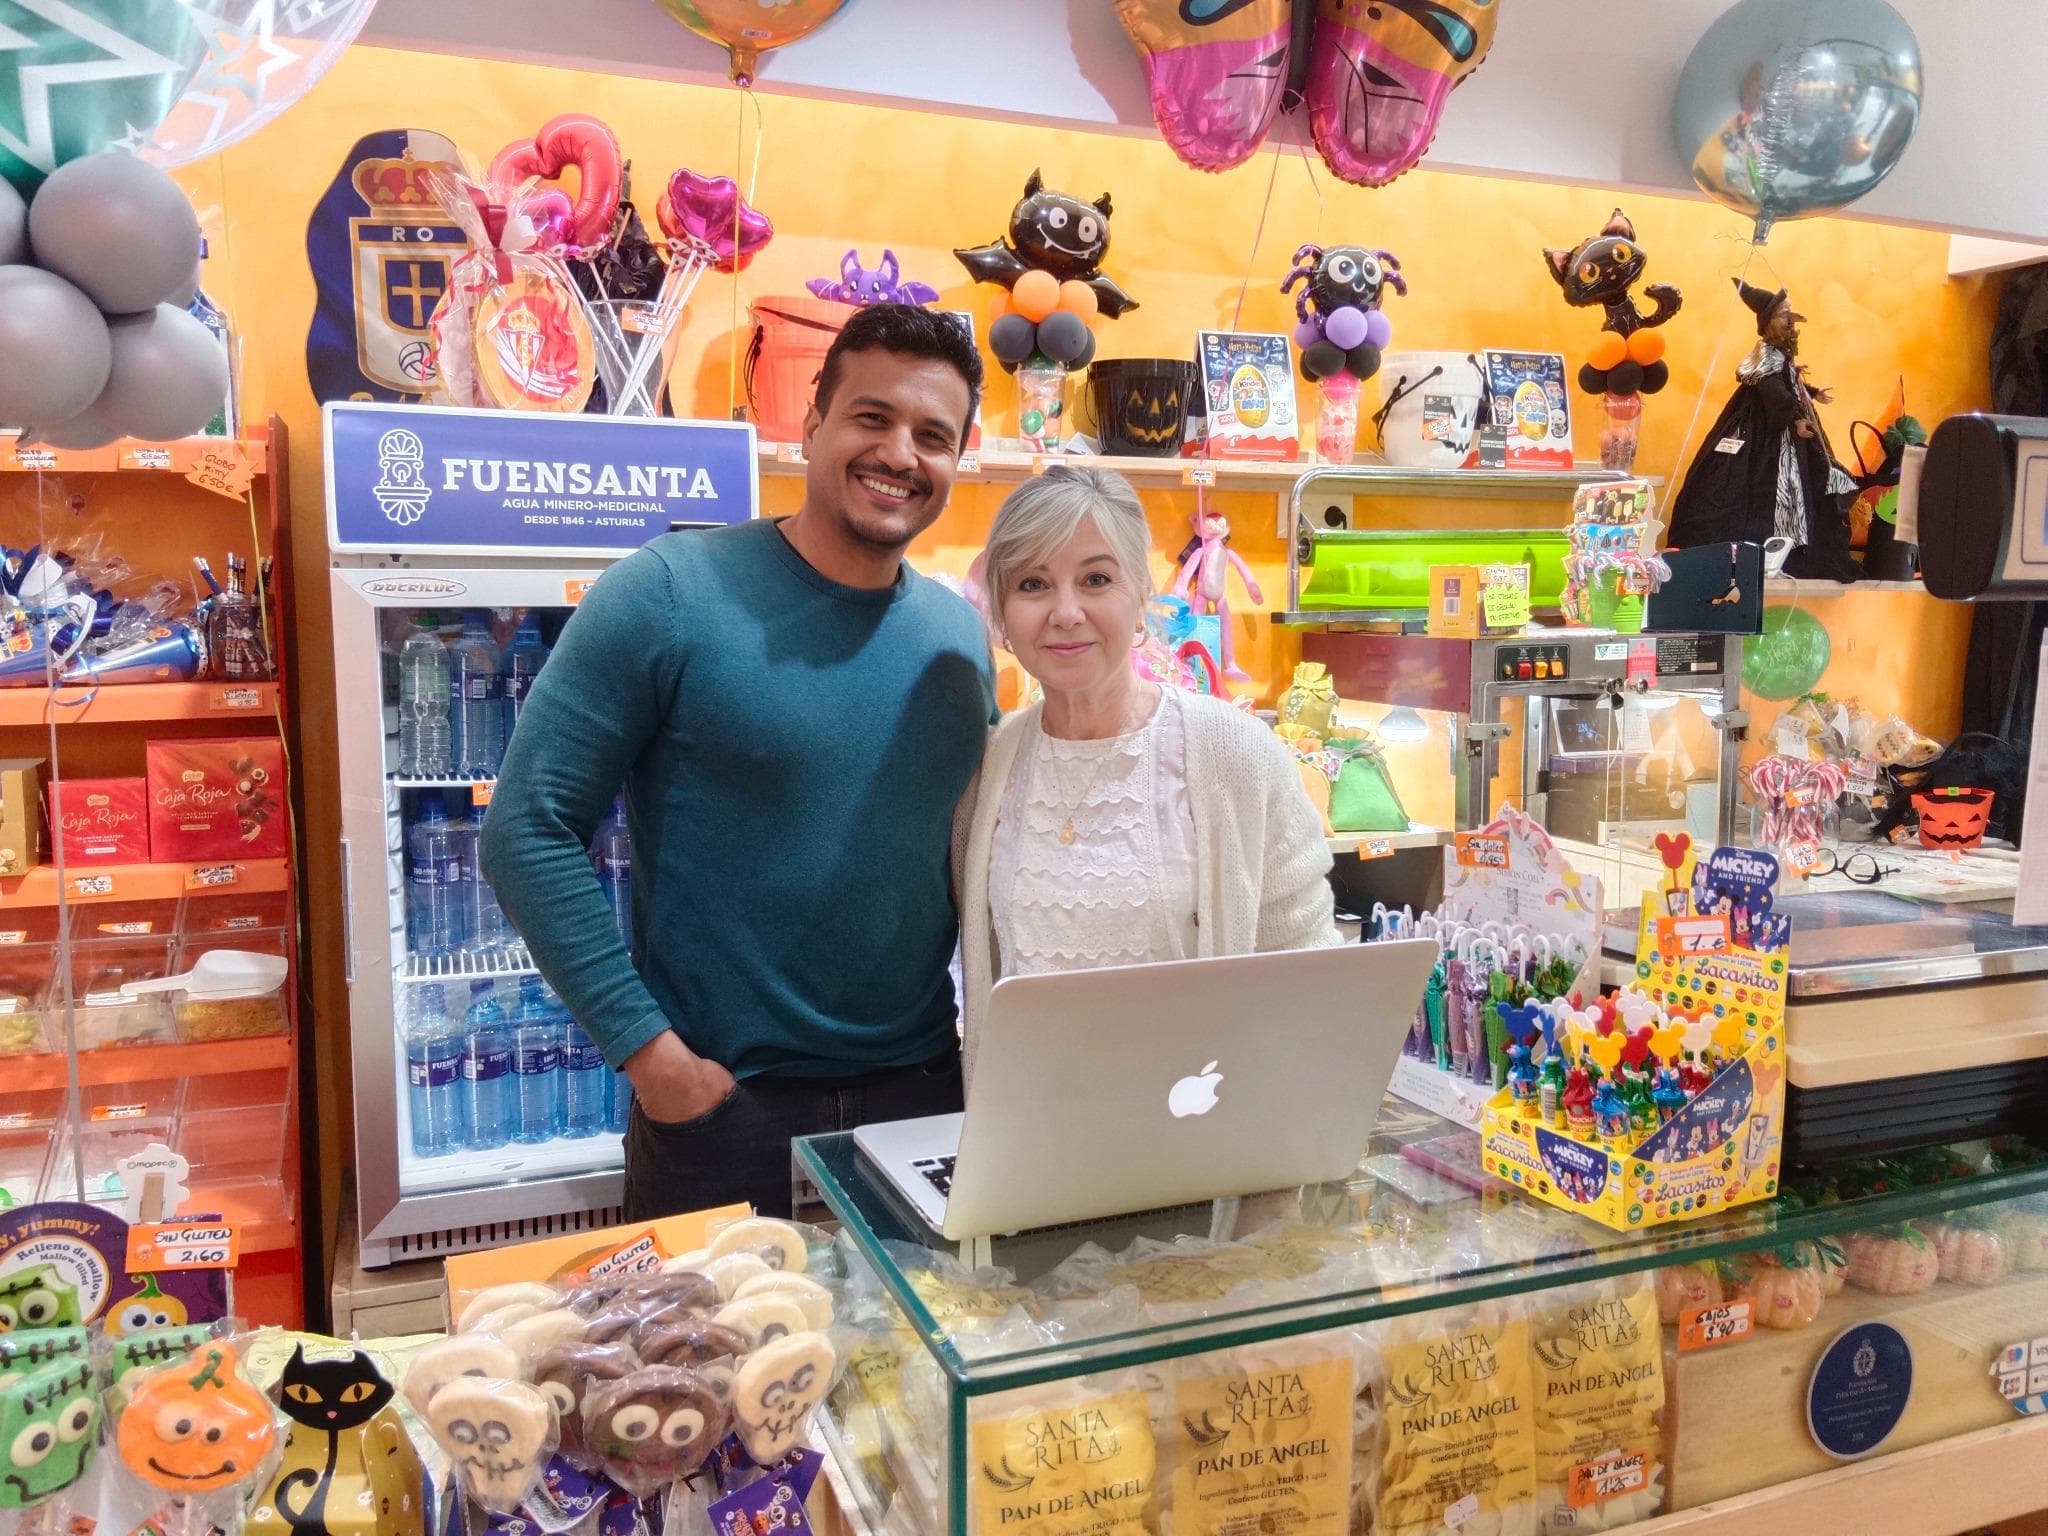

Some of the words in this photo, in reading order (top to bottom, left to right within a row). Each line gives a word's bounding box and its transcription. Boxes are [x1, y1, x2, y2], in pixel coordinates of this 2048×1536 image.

[205, 454, 236, 471] GLOBO
[441, 458, 719, 500] FUENSANTA
[502, 498, 540, 510] AGUA
[544, 499, 666, 513] MINERO-MEDICINAL
[524, 515, 559, 525] DESDE
[562, 516, 585, 526] 1846
[595, 516, 646, 528] ASTURIAS
[156, 787, 187, 808] Caja
[185, 783, 231, 806] Roja
[62, 812, 91, 832] Caja
[94, 807, 136, 830] Roja
[1712, 856, 1774, 879] MICKEY
[1718, 872, 1734, 880] AND
[1735, 875, 1766, 886] FRIENDS
[1694, 958, 1779, 991] Lacasitos
[1693, 1099, 1725, 1112] MICKEY
[1486, 1137, 1542, 1171] Lacasitos
[1554, 1144, 1594, 1168] MICKEY
[1655, 1174, 1725, 1202] Lacasitos
[17, 1217, 101, 1241] yummy!
[155, 1231, 179, 1244] SIN
[181, 1228, 232, 1243] GLUTEN
[16, 1242, 70, 1261] Relleno
[72, 1245, 87, 1259] de
[612, 1236, 655, 1265] GLUTEN
[40, 1253, 76, 1265] Mallow
[75, 1263, 89, 1286] filled
[1568, 1299, 1632, 1332] SANTA
[1425, 1333, 1492, 1368] SANTA
[1577, 1323, 1630, 1353] RITA
[1432, 1357, 1488, 1388] RITA
[1547, 1378, 1581, 1399] PAN
[1586, 1374, 1608, 1391] DE
[1609, 1362, 1656, 1387] ANGEL
[1226, 1373, 1304, 1405] SANTA
[1231, 1396, 1296, 1426] RITA
[1402, 1415, 1436, 1436] PAN
[1440, 1408, 1462, 1429] DE
[1466, 1396, 1520, 1424] ANGEL
[1025, 1408, 1109, 1447] SANTA
[1035, 1435, 1104, 1471] RITA
[1198, 1454, 1234, 1476] PAN
[1240, 1449, 1264, 1468] DE
[1269, 1438, 1331, 1464] ANGEL
[1001, 1502, 1041, 1525] PAN
[1049, 1495, 1074, 1515] DE
[1080, 1478, 1145, 1510] ANGEL
